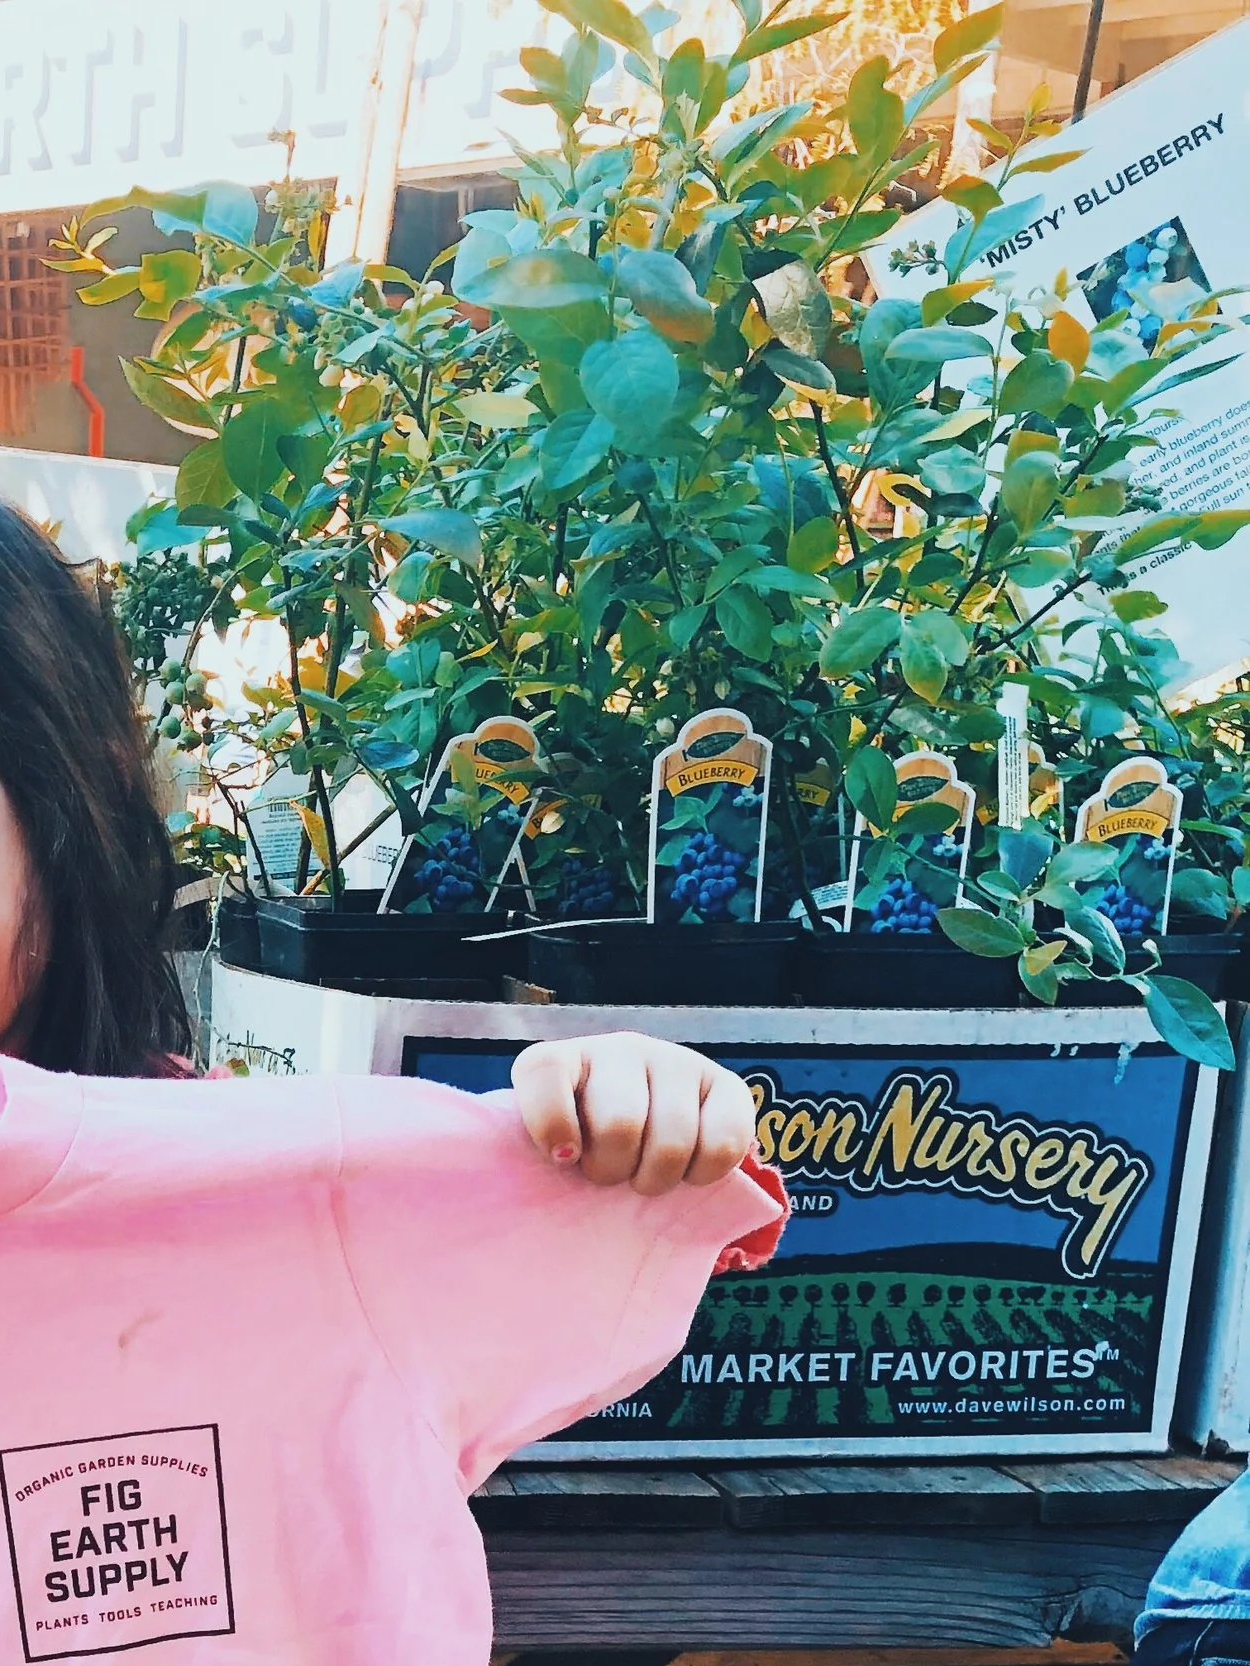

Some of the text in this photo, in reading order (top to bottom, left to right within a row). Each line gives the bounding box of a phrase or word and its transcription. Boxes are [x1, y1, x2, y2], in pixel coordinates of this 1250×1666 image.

[1073, 113, 1225, 216] BLUEBERRY
[1168, 416, 1223, 450] blueberry
[1159, 454, 1182, 473] and
[1183, 433, 1219, 459] inland
[1184, 457, 1206, 476] and
[1208, 440, 1238, 464] plant
[1169, 473, 1210, 500] berries
[1212, 461, 1230, 477] are
[1222, 487, 1245, 504] sun
[1139, 565, 1148, 575] a
[1149, 541, 1192, 569] classic
[677, 766, 746, 788] BLUEBERRY
[1098, 817, 1158, 838] BLUEBERRY
[862, 1083, 1139, 1267] Nursery
[789, 1194, 833, 1211] AND
[680, 1352, 856, 1385] MARKET
[898, 1396, 1126, 1414] www.davewilson.com
[14, 1454, 209, 1502] ORGANIC GARDEN SUPPLIES
[80, 1479, 142, 1517] FIG
[50, 1514, 178, 1562] EARTH
[44, 1551, 189, 1603] SUPPLY
[35, 1594, 218, 1632] PLANTS TOOLS TEACHING
